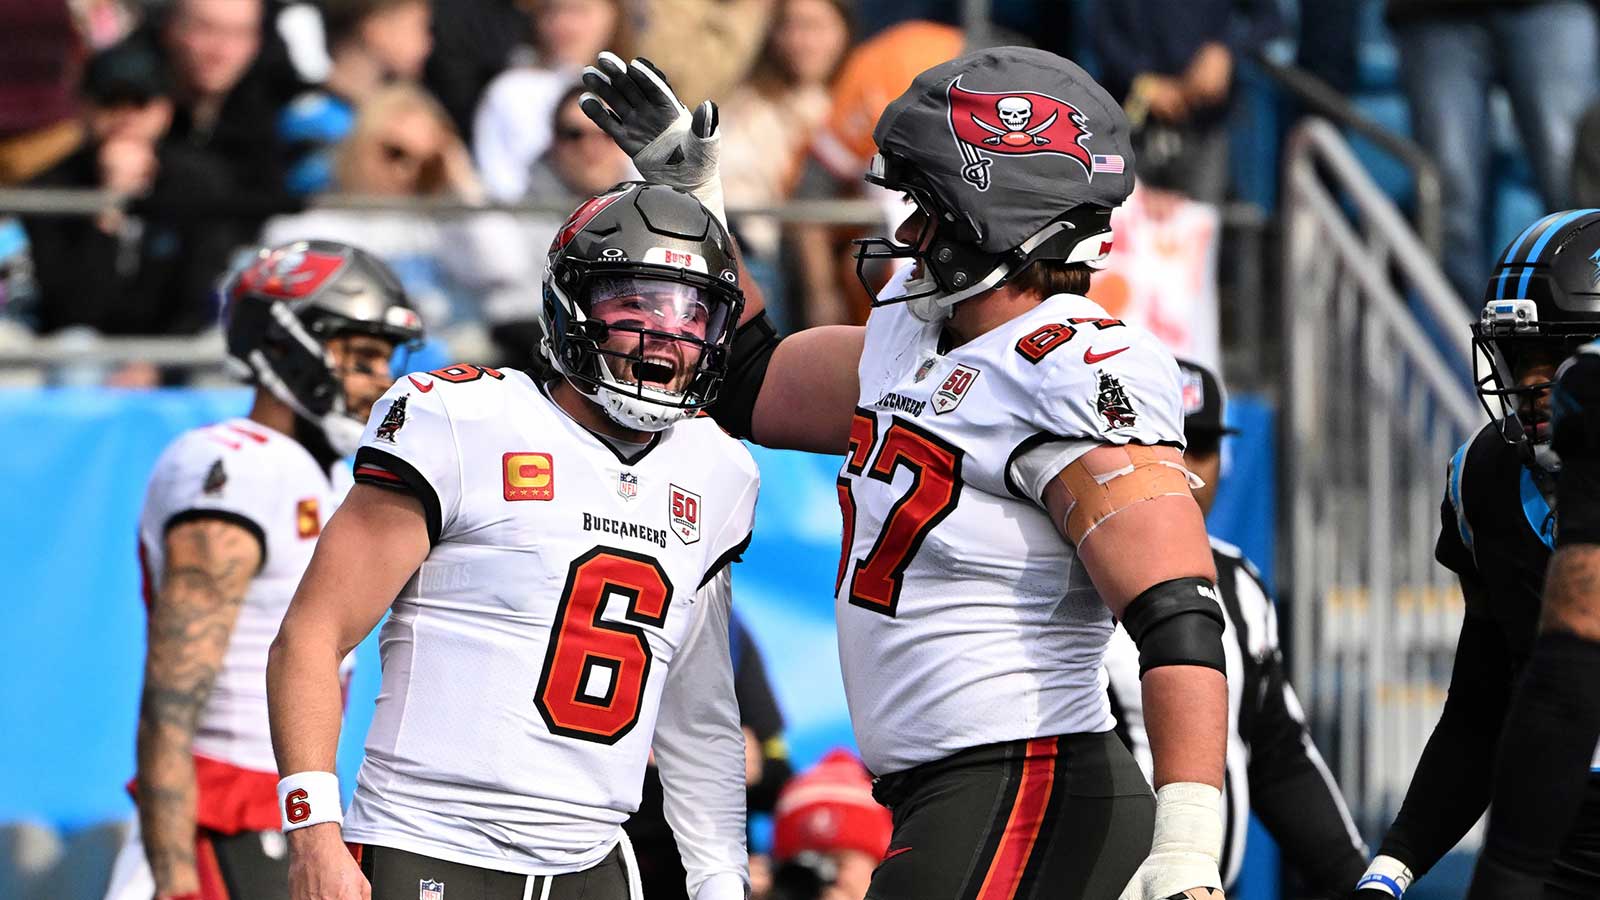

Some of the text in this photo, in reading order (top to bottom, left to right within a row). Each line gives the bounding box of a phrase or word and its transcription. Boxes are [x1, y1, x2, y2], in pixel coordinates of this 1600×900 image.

[942, 368, 973, 396] 50
[874, 392, 927, 418] CCANEERS
[507, 455, 551, 488] C
[621, 481, 637, 497] NFL
[672, 490, 697, 524] 50
[583, 512, 667, 549] BUCCANEERS
[533, 544, 674, 746] 6
[285, 787, 312, 825] 6
